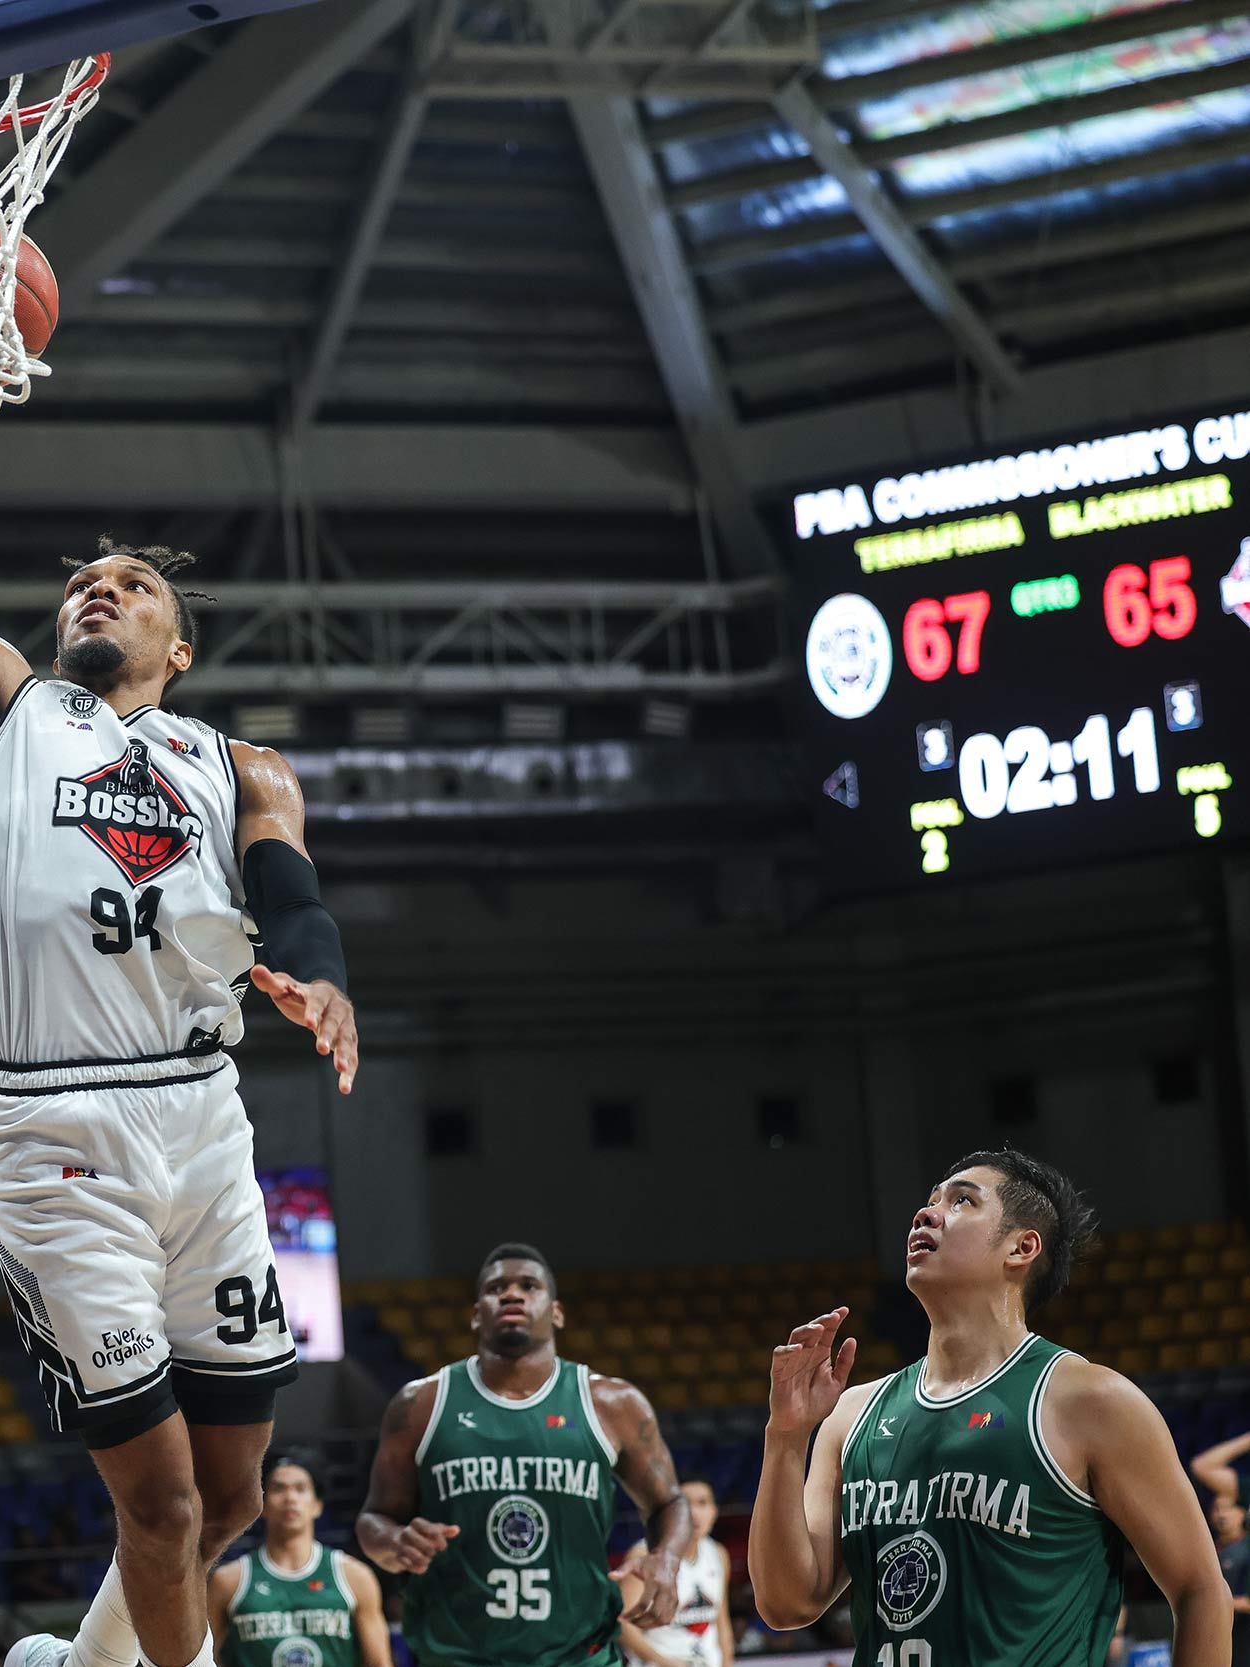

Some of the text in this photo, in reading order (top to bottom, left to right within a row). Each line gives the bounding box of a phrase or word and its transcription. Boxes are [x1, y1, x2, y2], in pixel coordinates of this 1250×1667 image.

[794, 484, 872, 538] PBA
[1103, 555, 1198, 648] 65
[903, 590, 991, 682] 67
[959, 706, 1161, 820] 02:11
[90, 885, 164, 955] 94
[214, 1263, 288, 1346] 94
[92, 1334, 155, 1369] Organics
[101, 1327, 136, 1350] Ever
[431, 1456, 600, 1502] TERRAFIRMA
[485, 1568, 552, 1622] 35
[892, 1610, 914, 1623] DYIP
